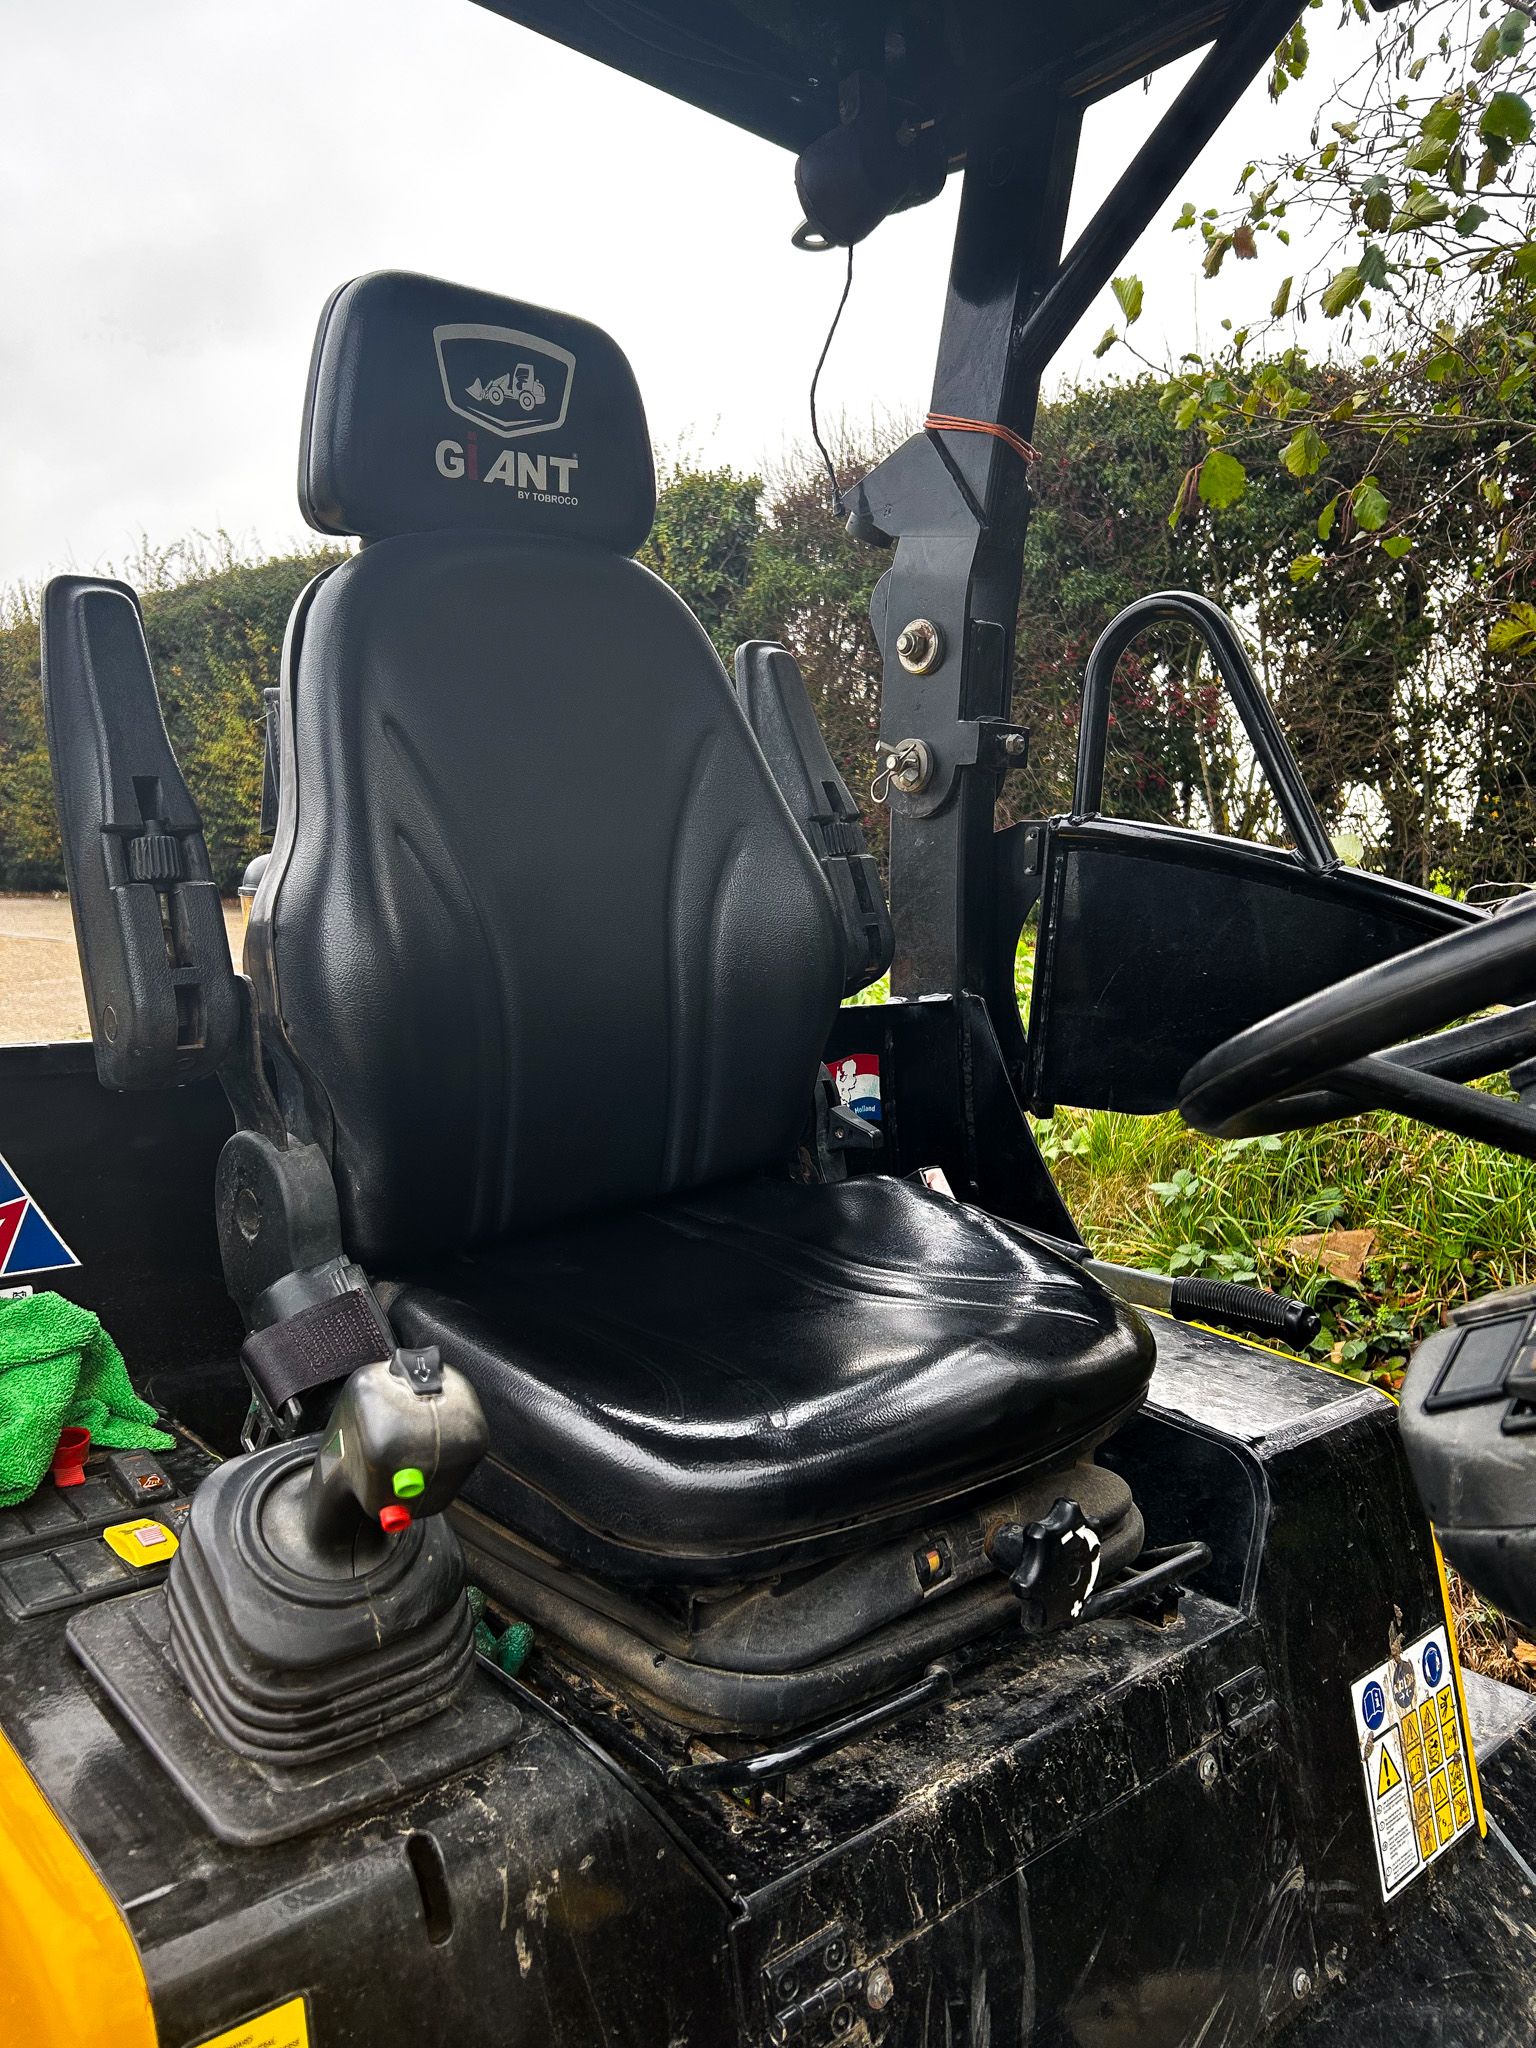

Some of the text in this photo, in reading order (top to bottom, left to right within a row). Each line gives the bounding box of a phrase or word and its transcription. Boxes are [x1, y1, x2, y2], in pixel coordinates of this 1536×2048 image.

[517, 490, 579, 506] BY TOBROCO
[854, 1105, 876, 1114] Holland
